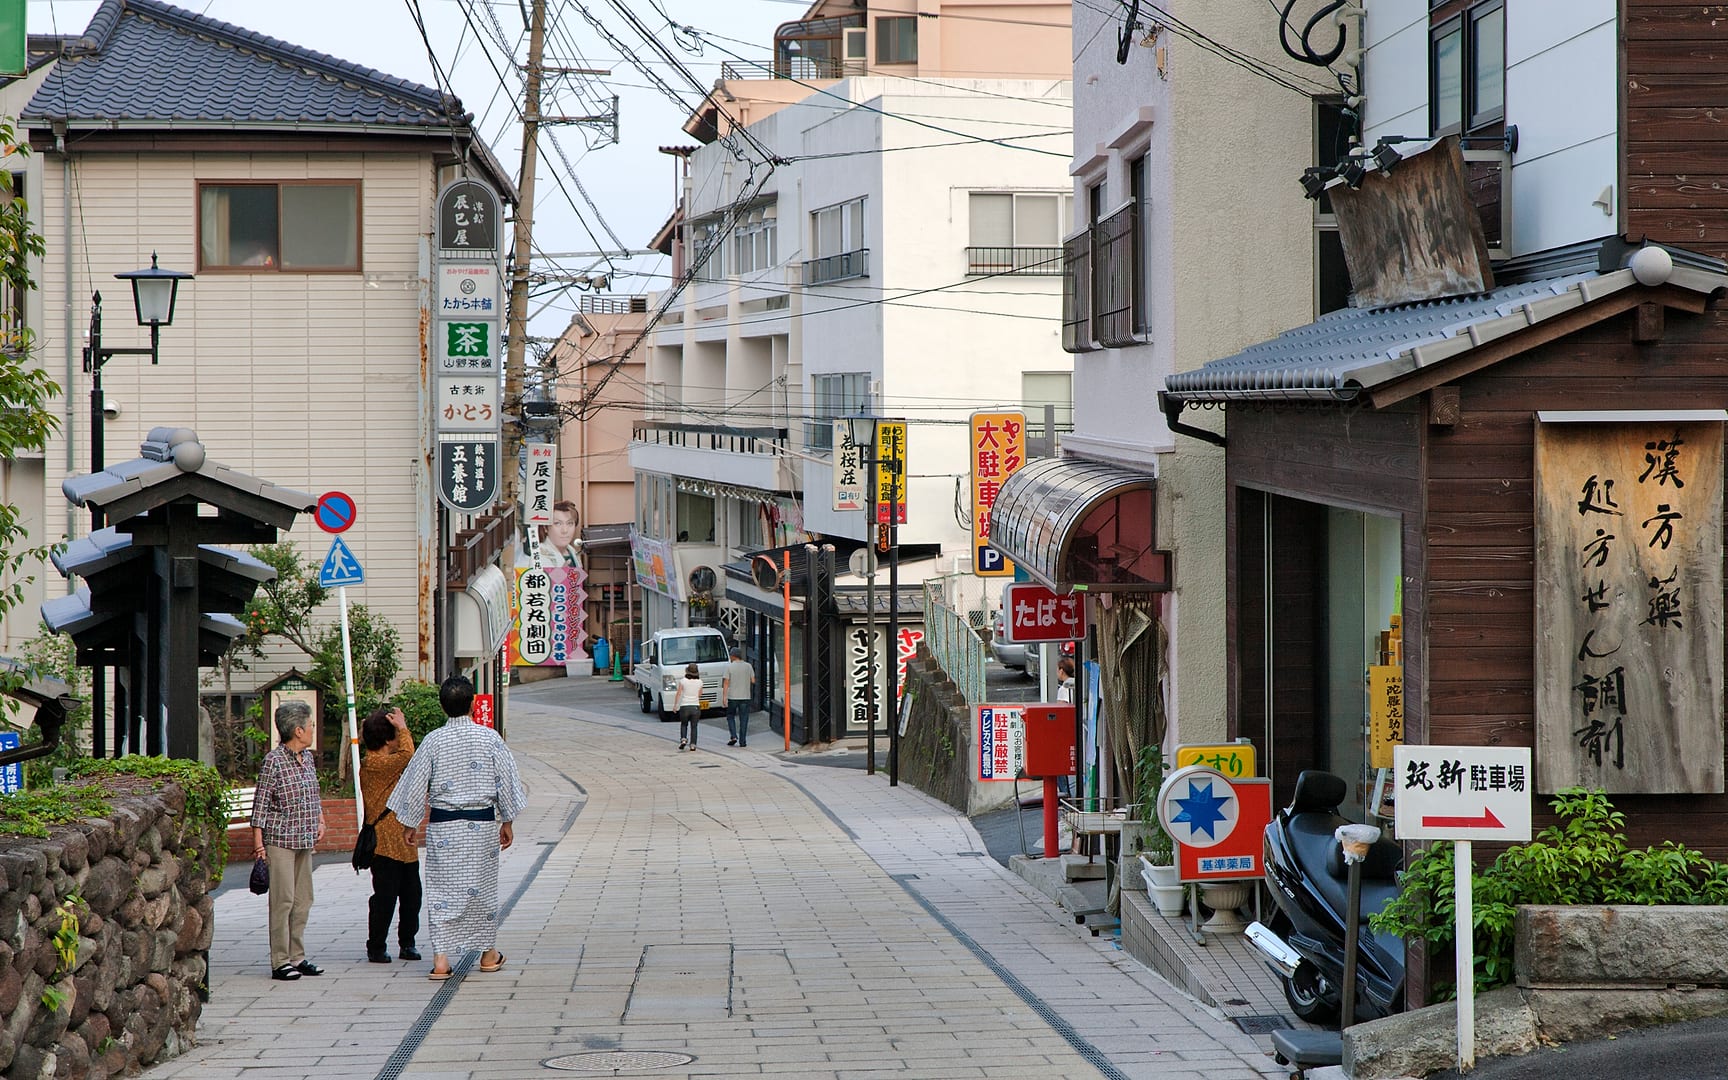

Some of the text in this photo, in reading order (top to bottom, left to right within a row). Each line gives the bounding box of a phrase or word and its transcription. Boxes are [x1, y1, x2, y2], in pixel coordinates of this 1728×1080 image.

[452, 194, 470, 246] 辰巳屋
[443, 297, 492, 311] たから本舗
[454, 326, 483, 354] 茶
[449, 384, 486, 396] 古美術
[443, 403, 493, 421] かとう
[531, 461, 551, 512] 辰巳屋
[985, 549, 1000, 569] P
[525, 574, 546, 654] 都若丸劇団
[553, 584, 567, 661] いらっしゃいませ
[1015, 598, 1079, 628] たばこ
[1386, 685, 1403, 742] 陀羅尼助丸
[982, 710, 992, 777] テレビカメラ監視中
[994, 713, 1008, 774] 駐車厳禁
[1201, 857, 1251, 871] 基準薬局
